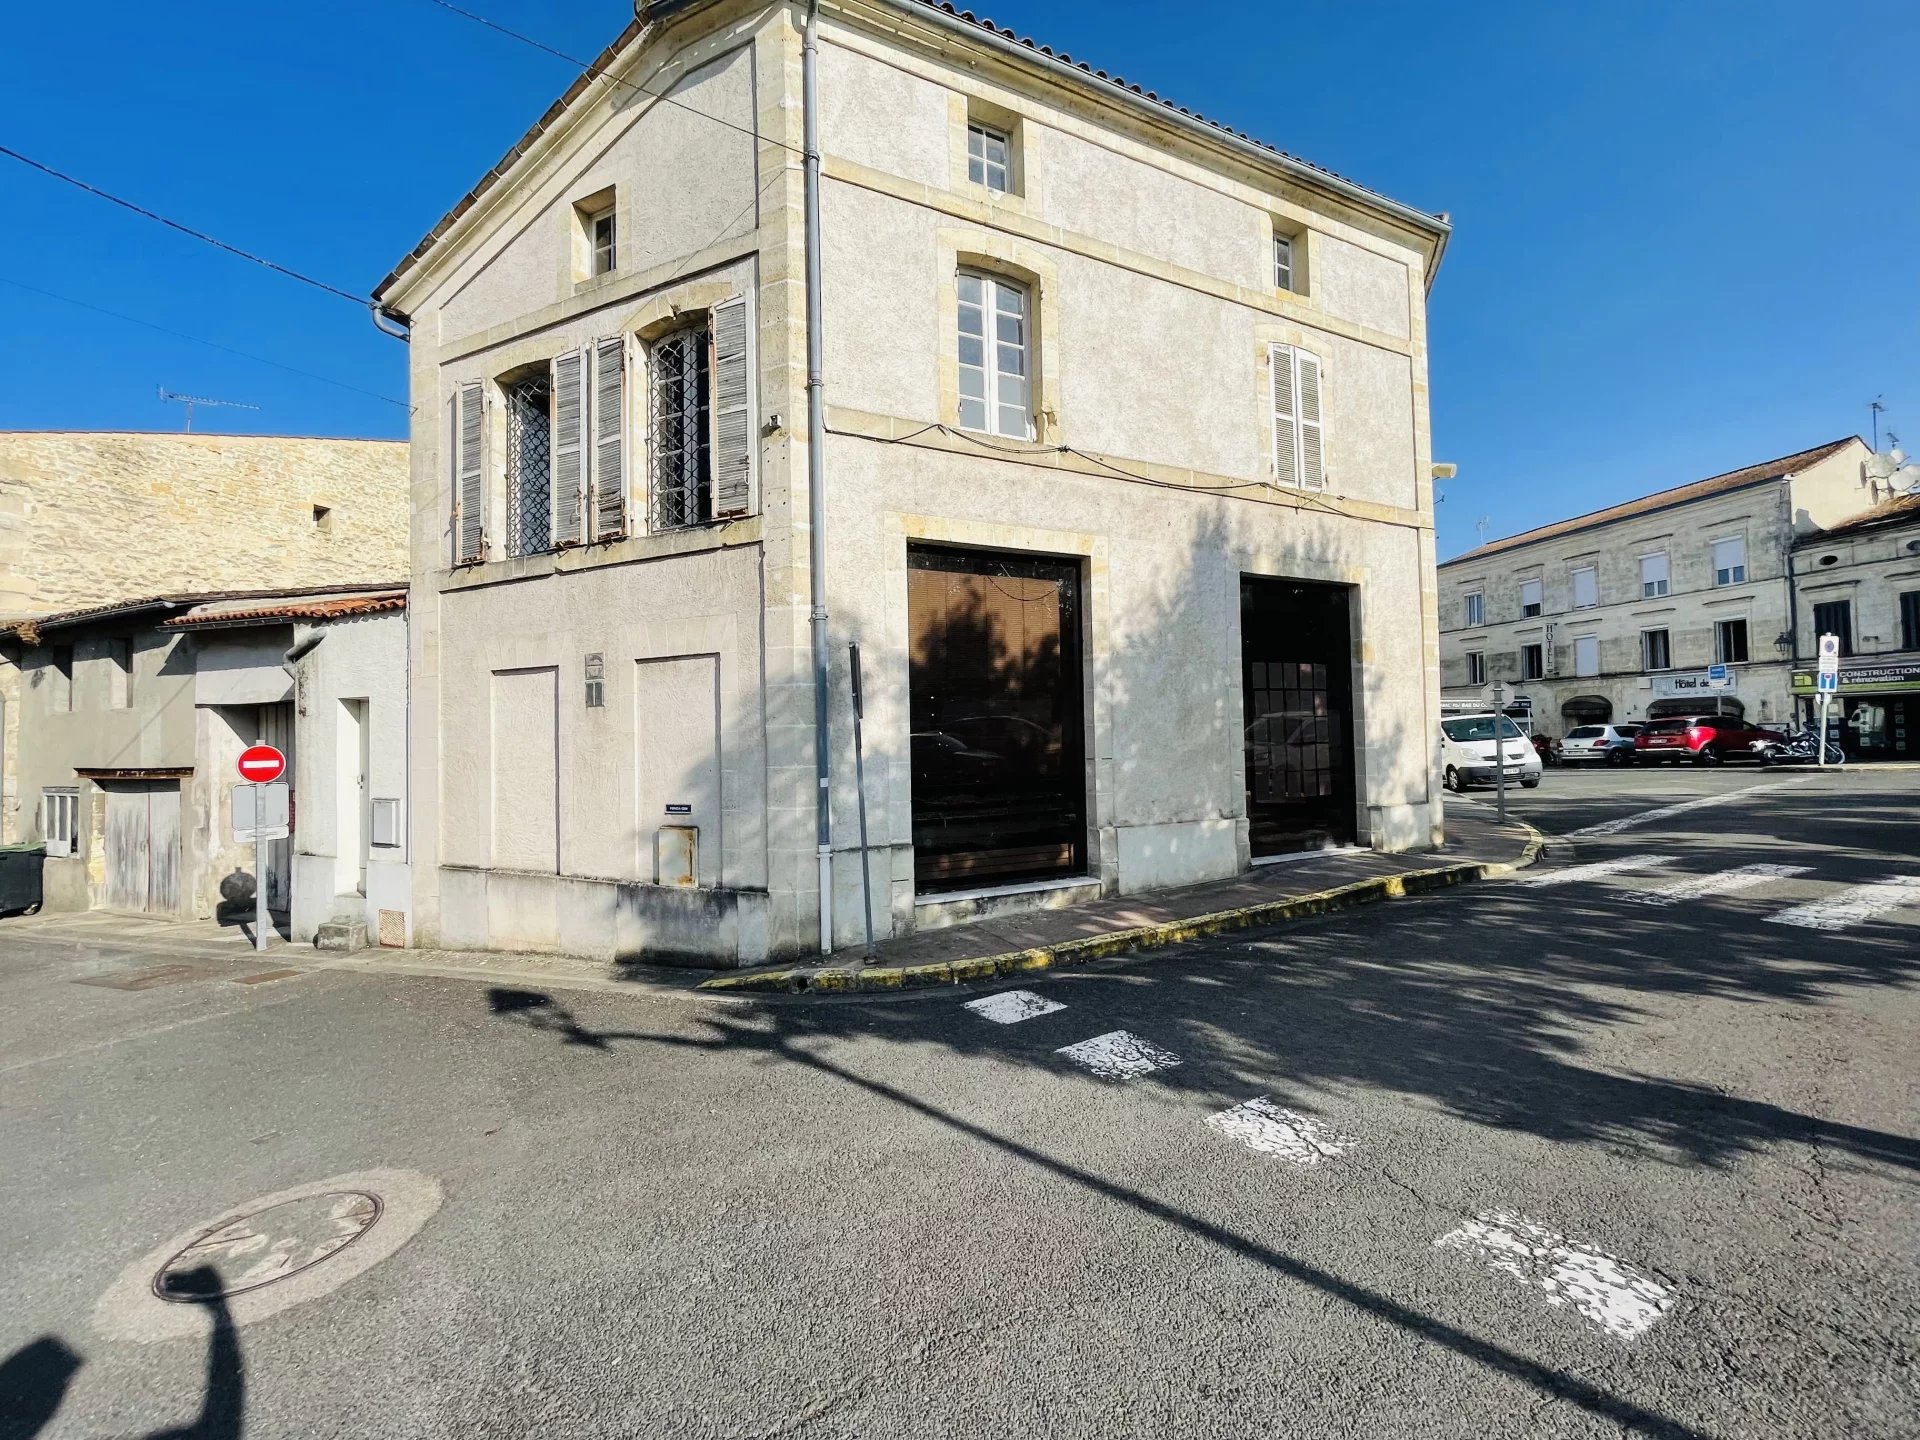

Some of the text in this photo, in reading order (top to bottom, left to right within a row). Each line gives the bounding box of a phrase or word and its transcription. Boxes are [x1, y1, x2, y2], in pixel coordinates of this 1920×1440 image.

[1839, 667, 1920, 678] CONSTRUCTION
[1675, 677, 1697, 690] Hôtel
[1851, 675, 1905, 683] rénovation
